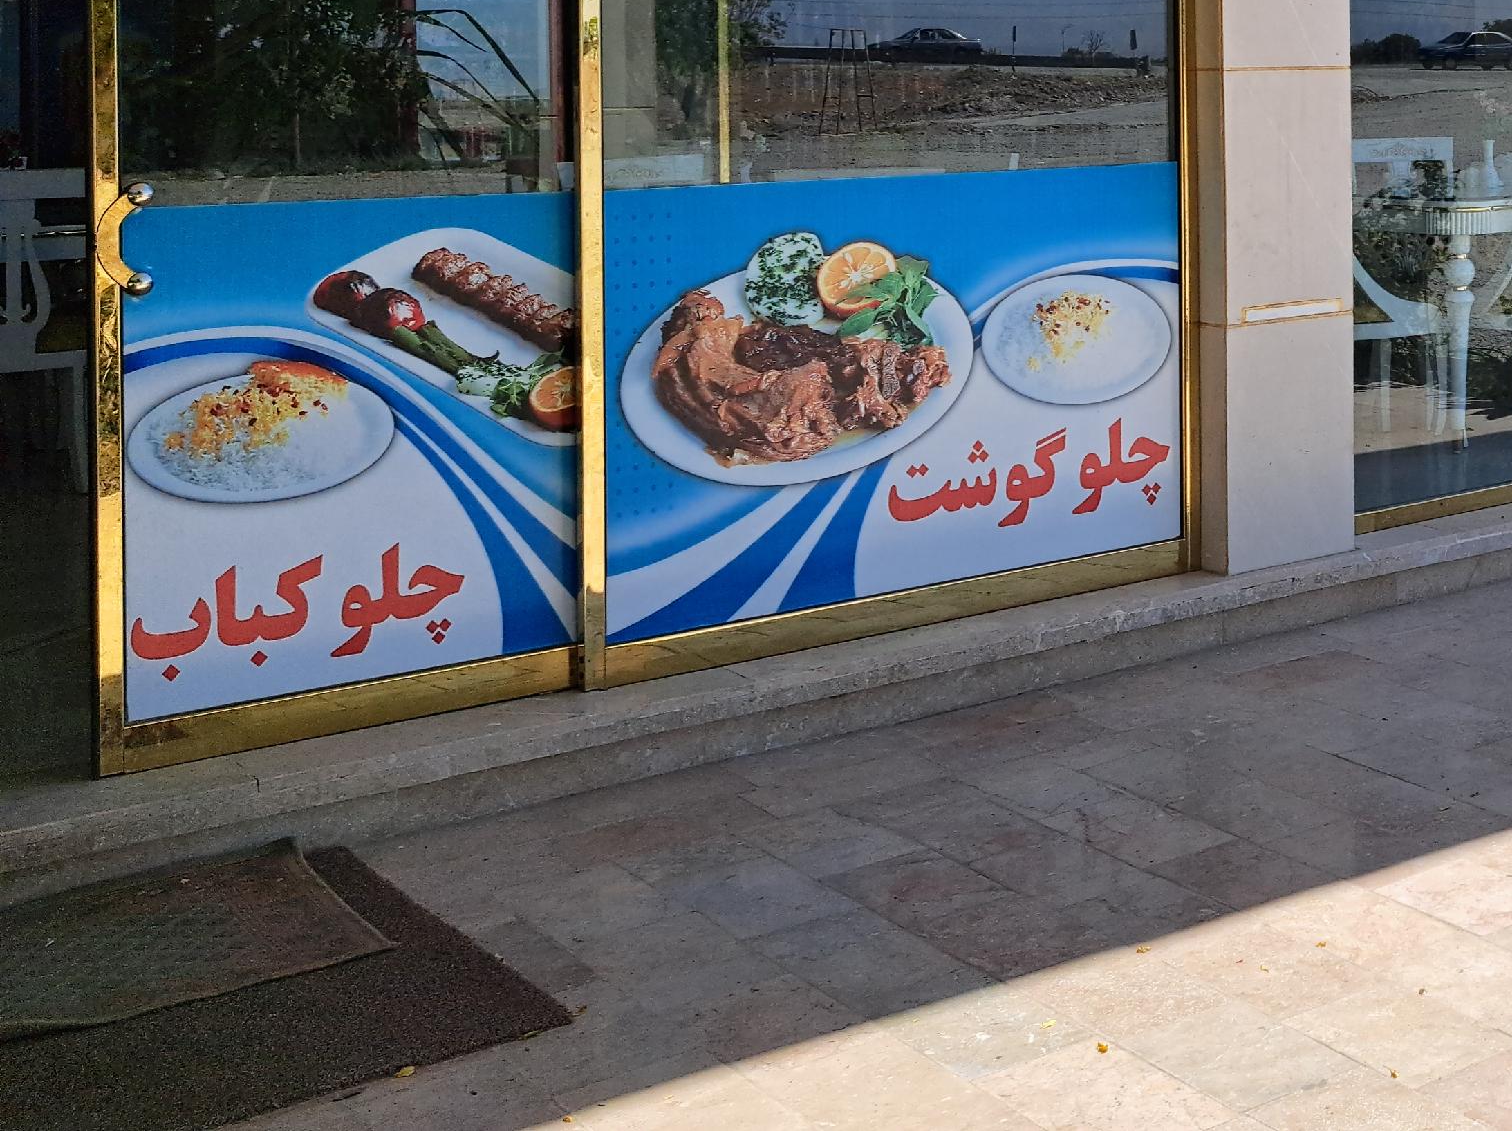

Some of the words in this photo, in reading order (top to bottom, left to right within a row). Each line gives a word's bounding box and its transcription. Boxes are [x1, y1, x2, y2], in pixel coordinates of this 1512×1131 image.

[887, 426, 1067, 528] گوشت
[1071, 417, 1171, 515] چلو
[130, 554, 325, 683] کباب
[330, 542, 466, 659] چلو
